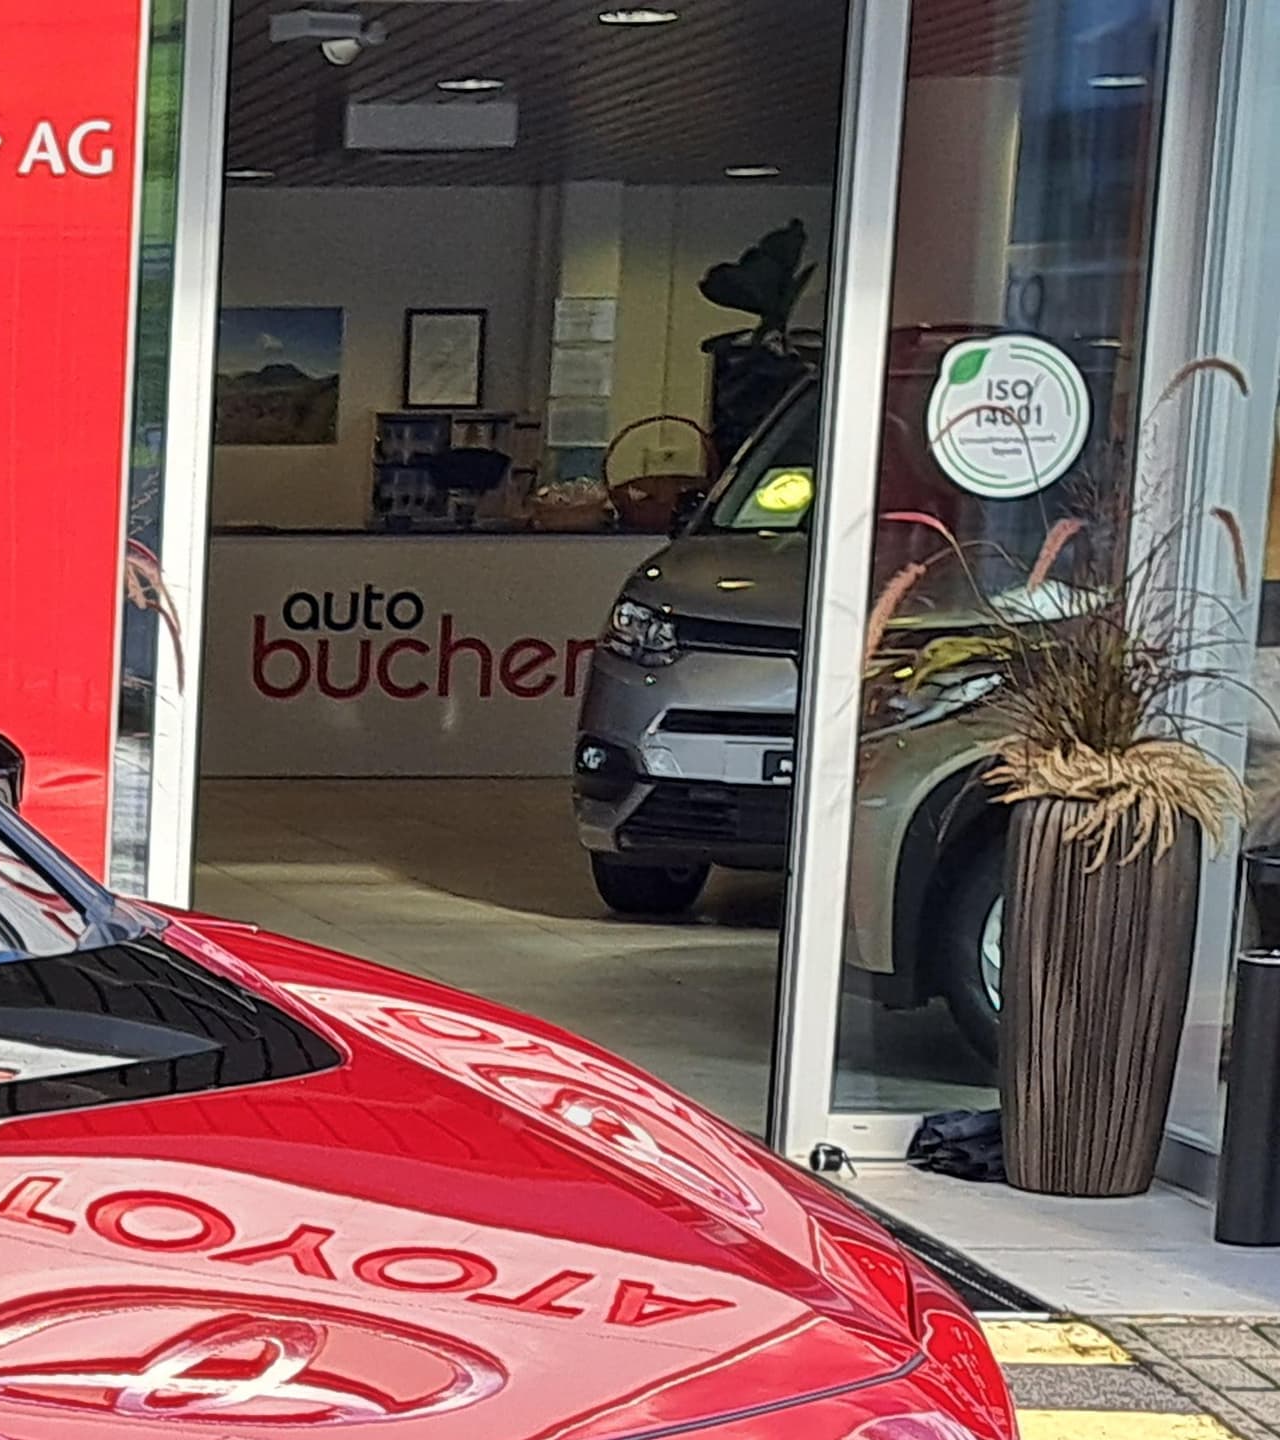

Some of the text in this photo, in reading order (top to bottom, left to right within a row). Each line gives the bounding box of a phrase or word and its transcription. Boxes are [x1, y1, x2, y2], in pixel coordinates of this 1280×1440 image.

[18, 120, 114, 176] AG
[986, 378, 1034, 401] ISO
[975, 404, 1043, 428] 14001
[282, 583, 425, 631] auto
[251, 614, 598, 699] bucher
